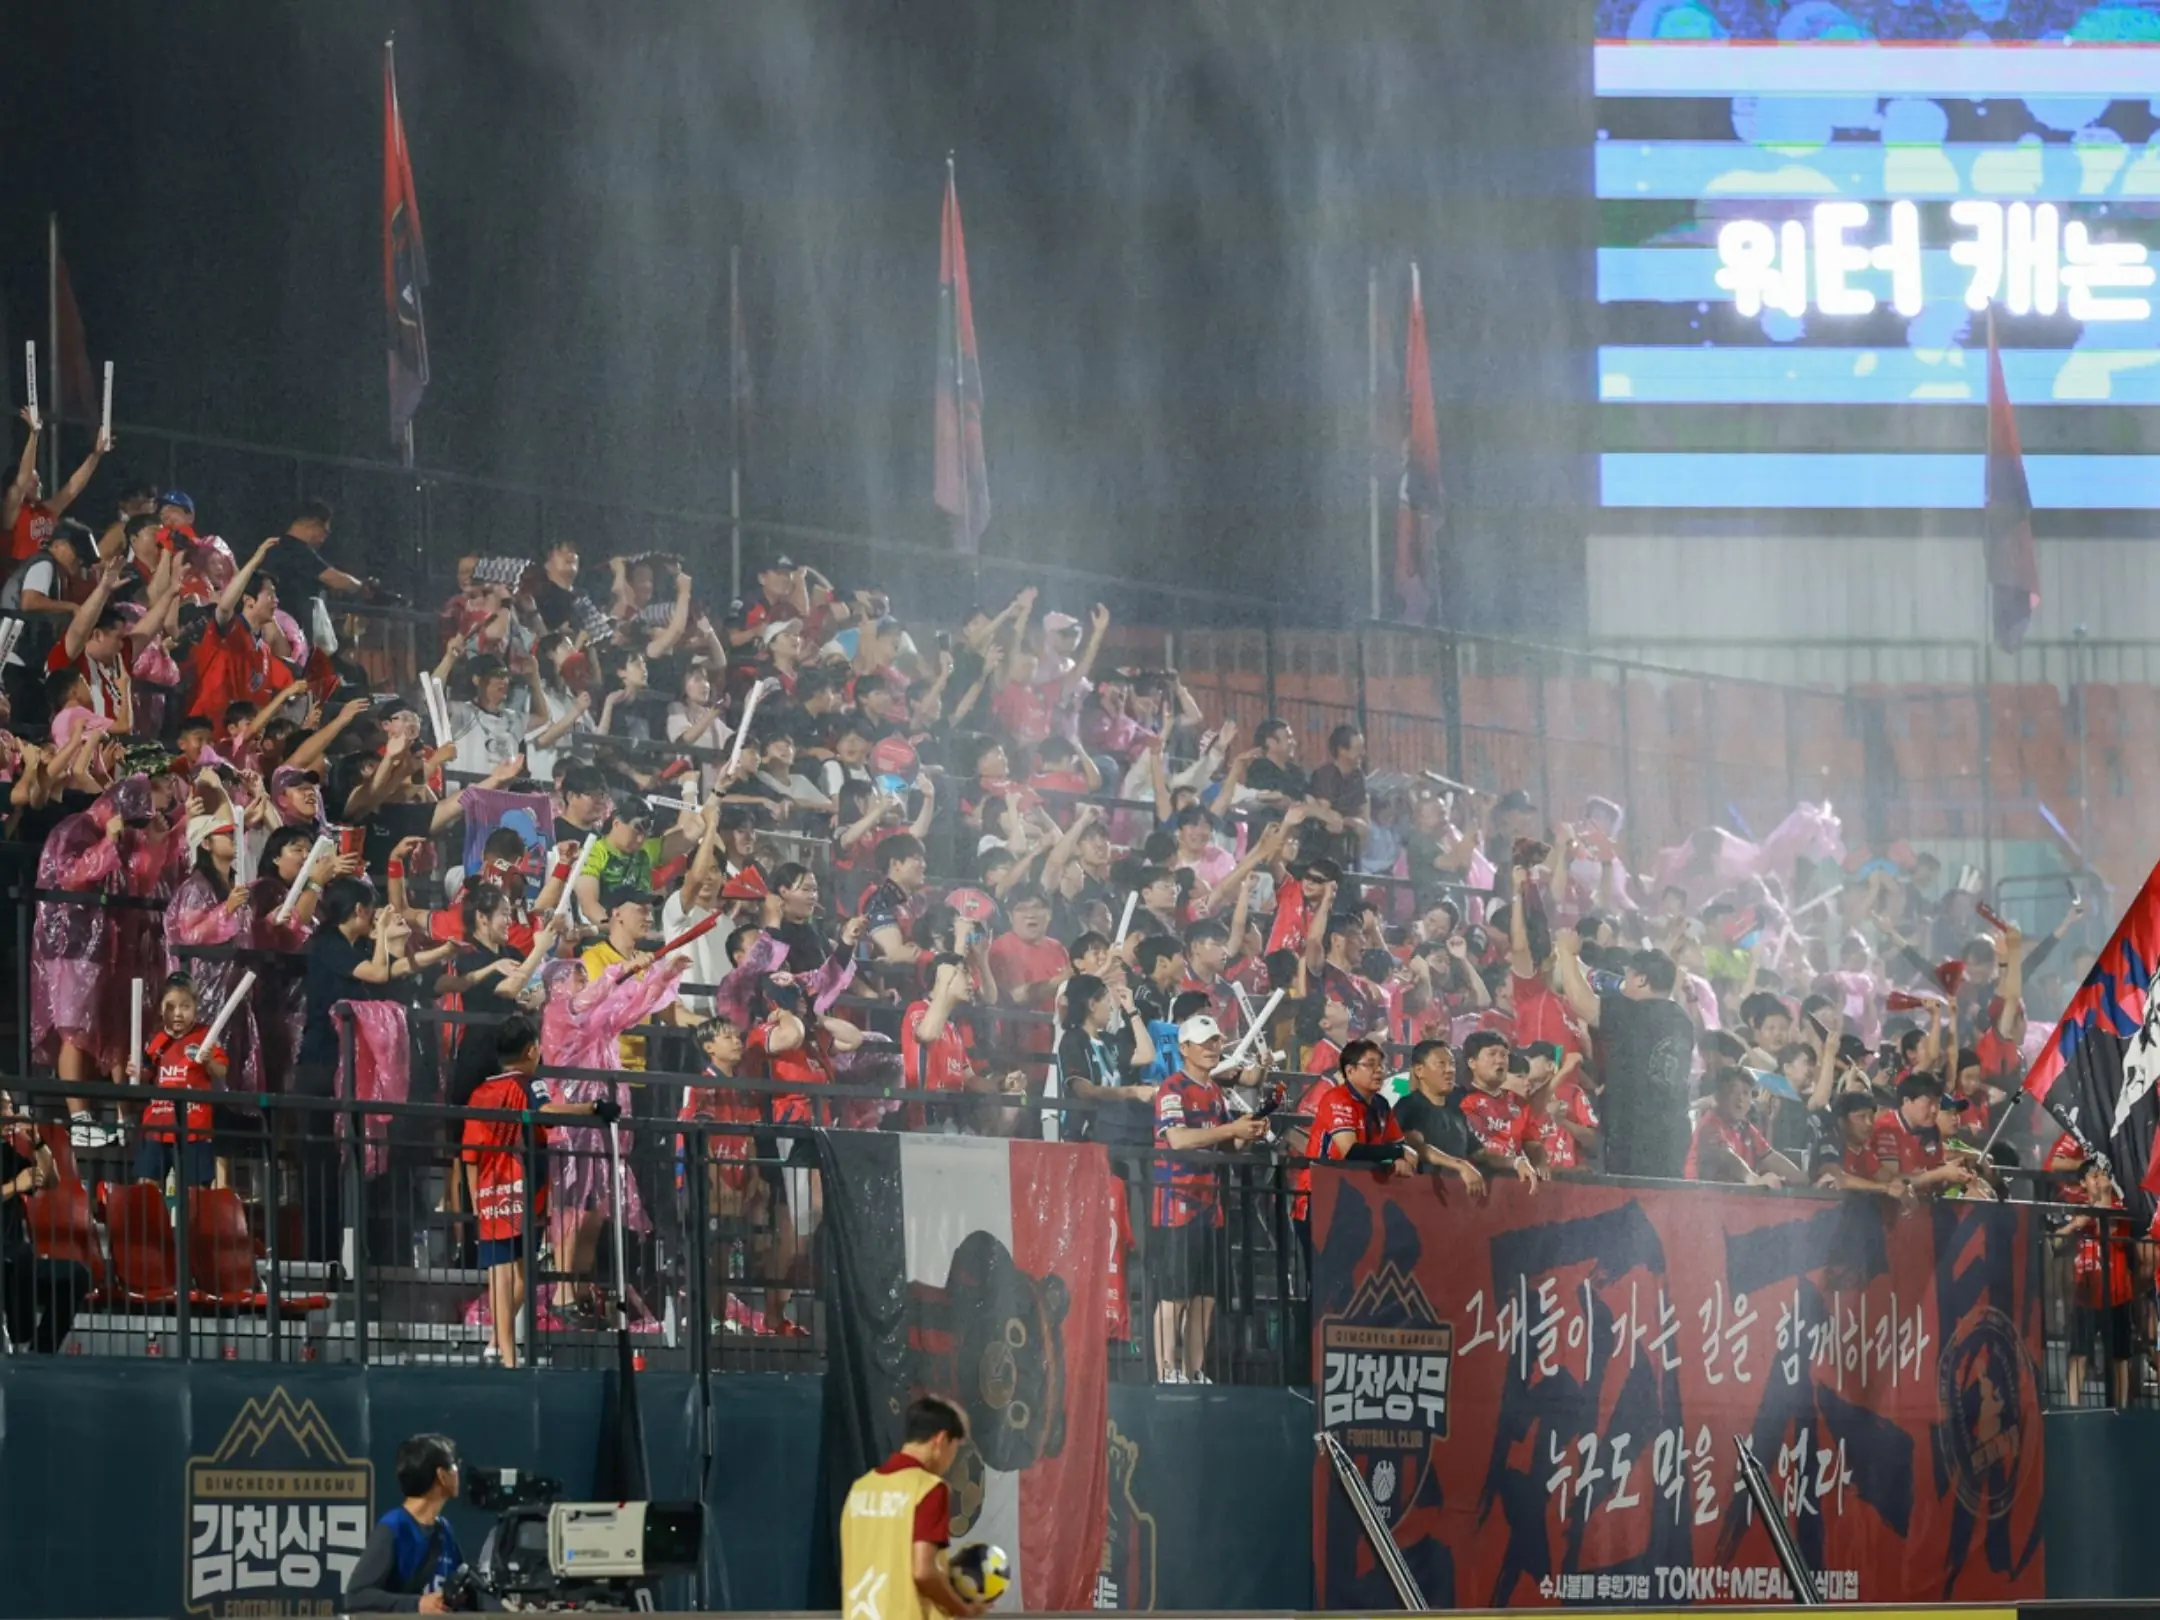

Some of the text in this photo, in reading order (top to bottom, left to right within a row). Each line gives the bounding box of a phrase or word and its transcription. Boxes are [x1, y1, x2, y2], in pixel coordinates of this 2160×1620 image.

[1714, 200, 1922, 318] 워터
[1458, 1273, 1931, 1391] 그대들이 가는 길을 함께하리라
[1324, 1352, 1448, 1428] 김천상무
[205, 1476, 356, 1493] GIMCHEON SANGMU
[1546, 1429, 1641, 1523] 누구도
[1652, 1424, 1720, 1526] 막을
[1778, 1427, 1854, 1516] 없다
[192, 1504, 368, 1600] 김천상무
[1597, 1574, 1650, 1599] 후원기업
